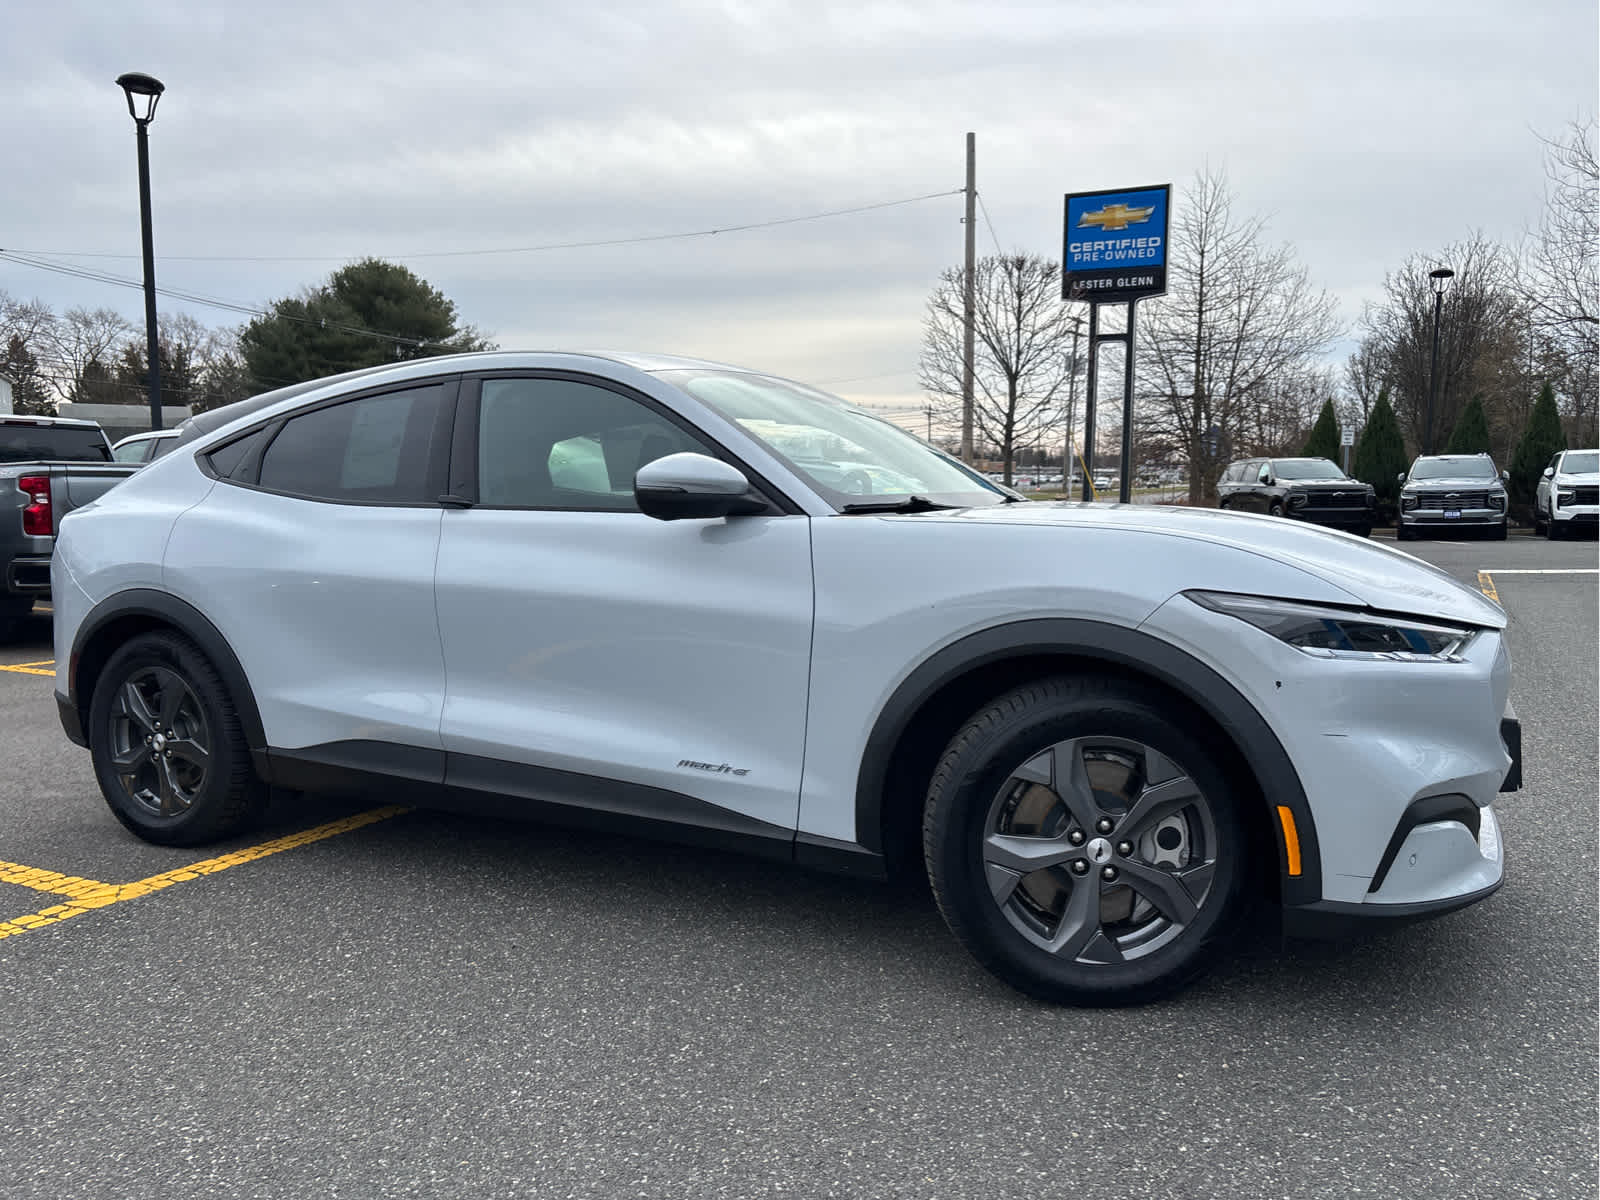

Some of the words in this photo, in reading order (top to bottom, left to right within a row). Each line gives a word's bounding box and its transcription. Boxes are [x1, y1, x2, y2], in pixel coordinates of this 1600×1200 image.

[1070, 237, 1161, 253] CERTIFIED
[1074, 248, 1155, 262] PRE-OWNED
[1073, 279, 1113, 289] LESTER
[1117, 276, 1153, 287] GLENN
